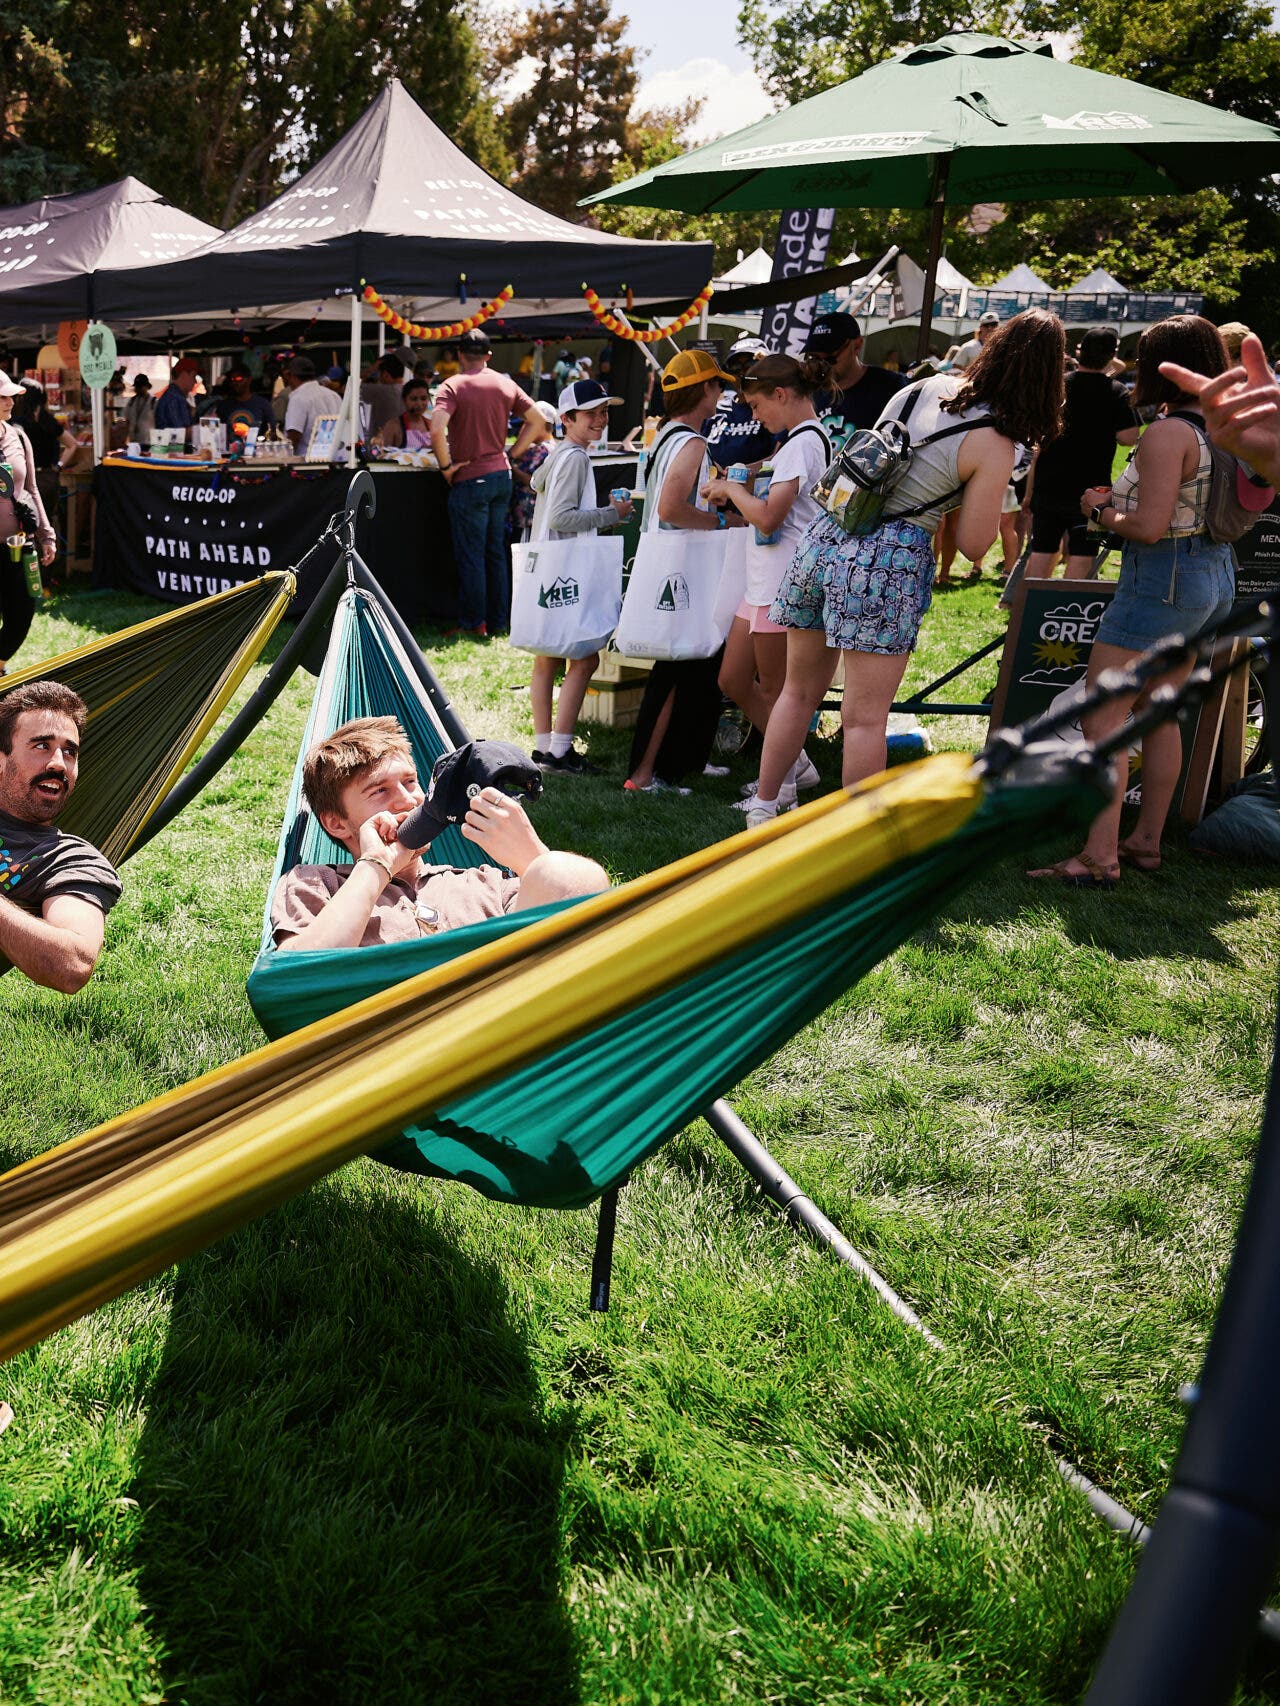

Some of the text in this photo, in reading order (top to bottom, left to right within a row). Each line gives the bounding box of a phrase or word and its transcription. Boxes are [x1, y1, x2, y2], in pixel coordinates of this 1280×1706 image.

[172, 486, 236, 504] REI CO-OP
[145, 536, 271, 566] PATH AHEAD
[549, 584, 580, 602] REI
[1040, 621, 1096, 643] CRE
